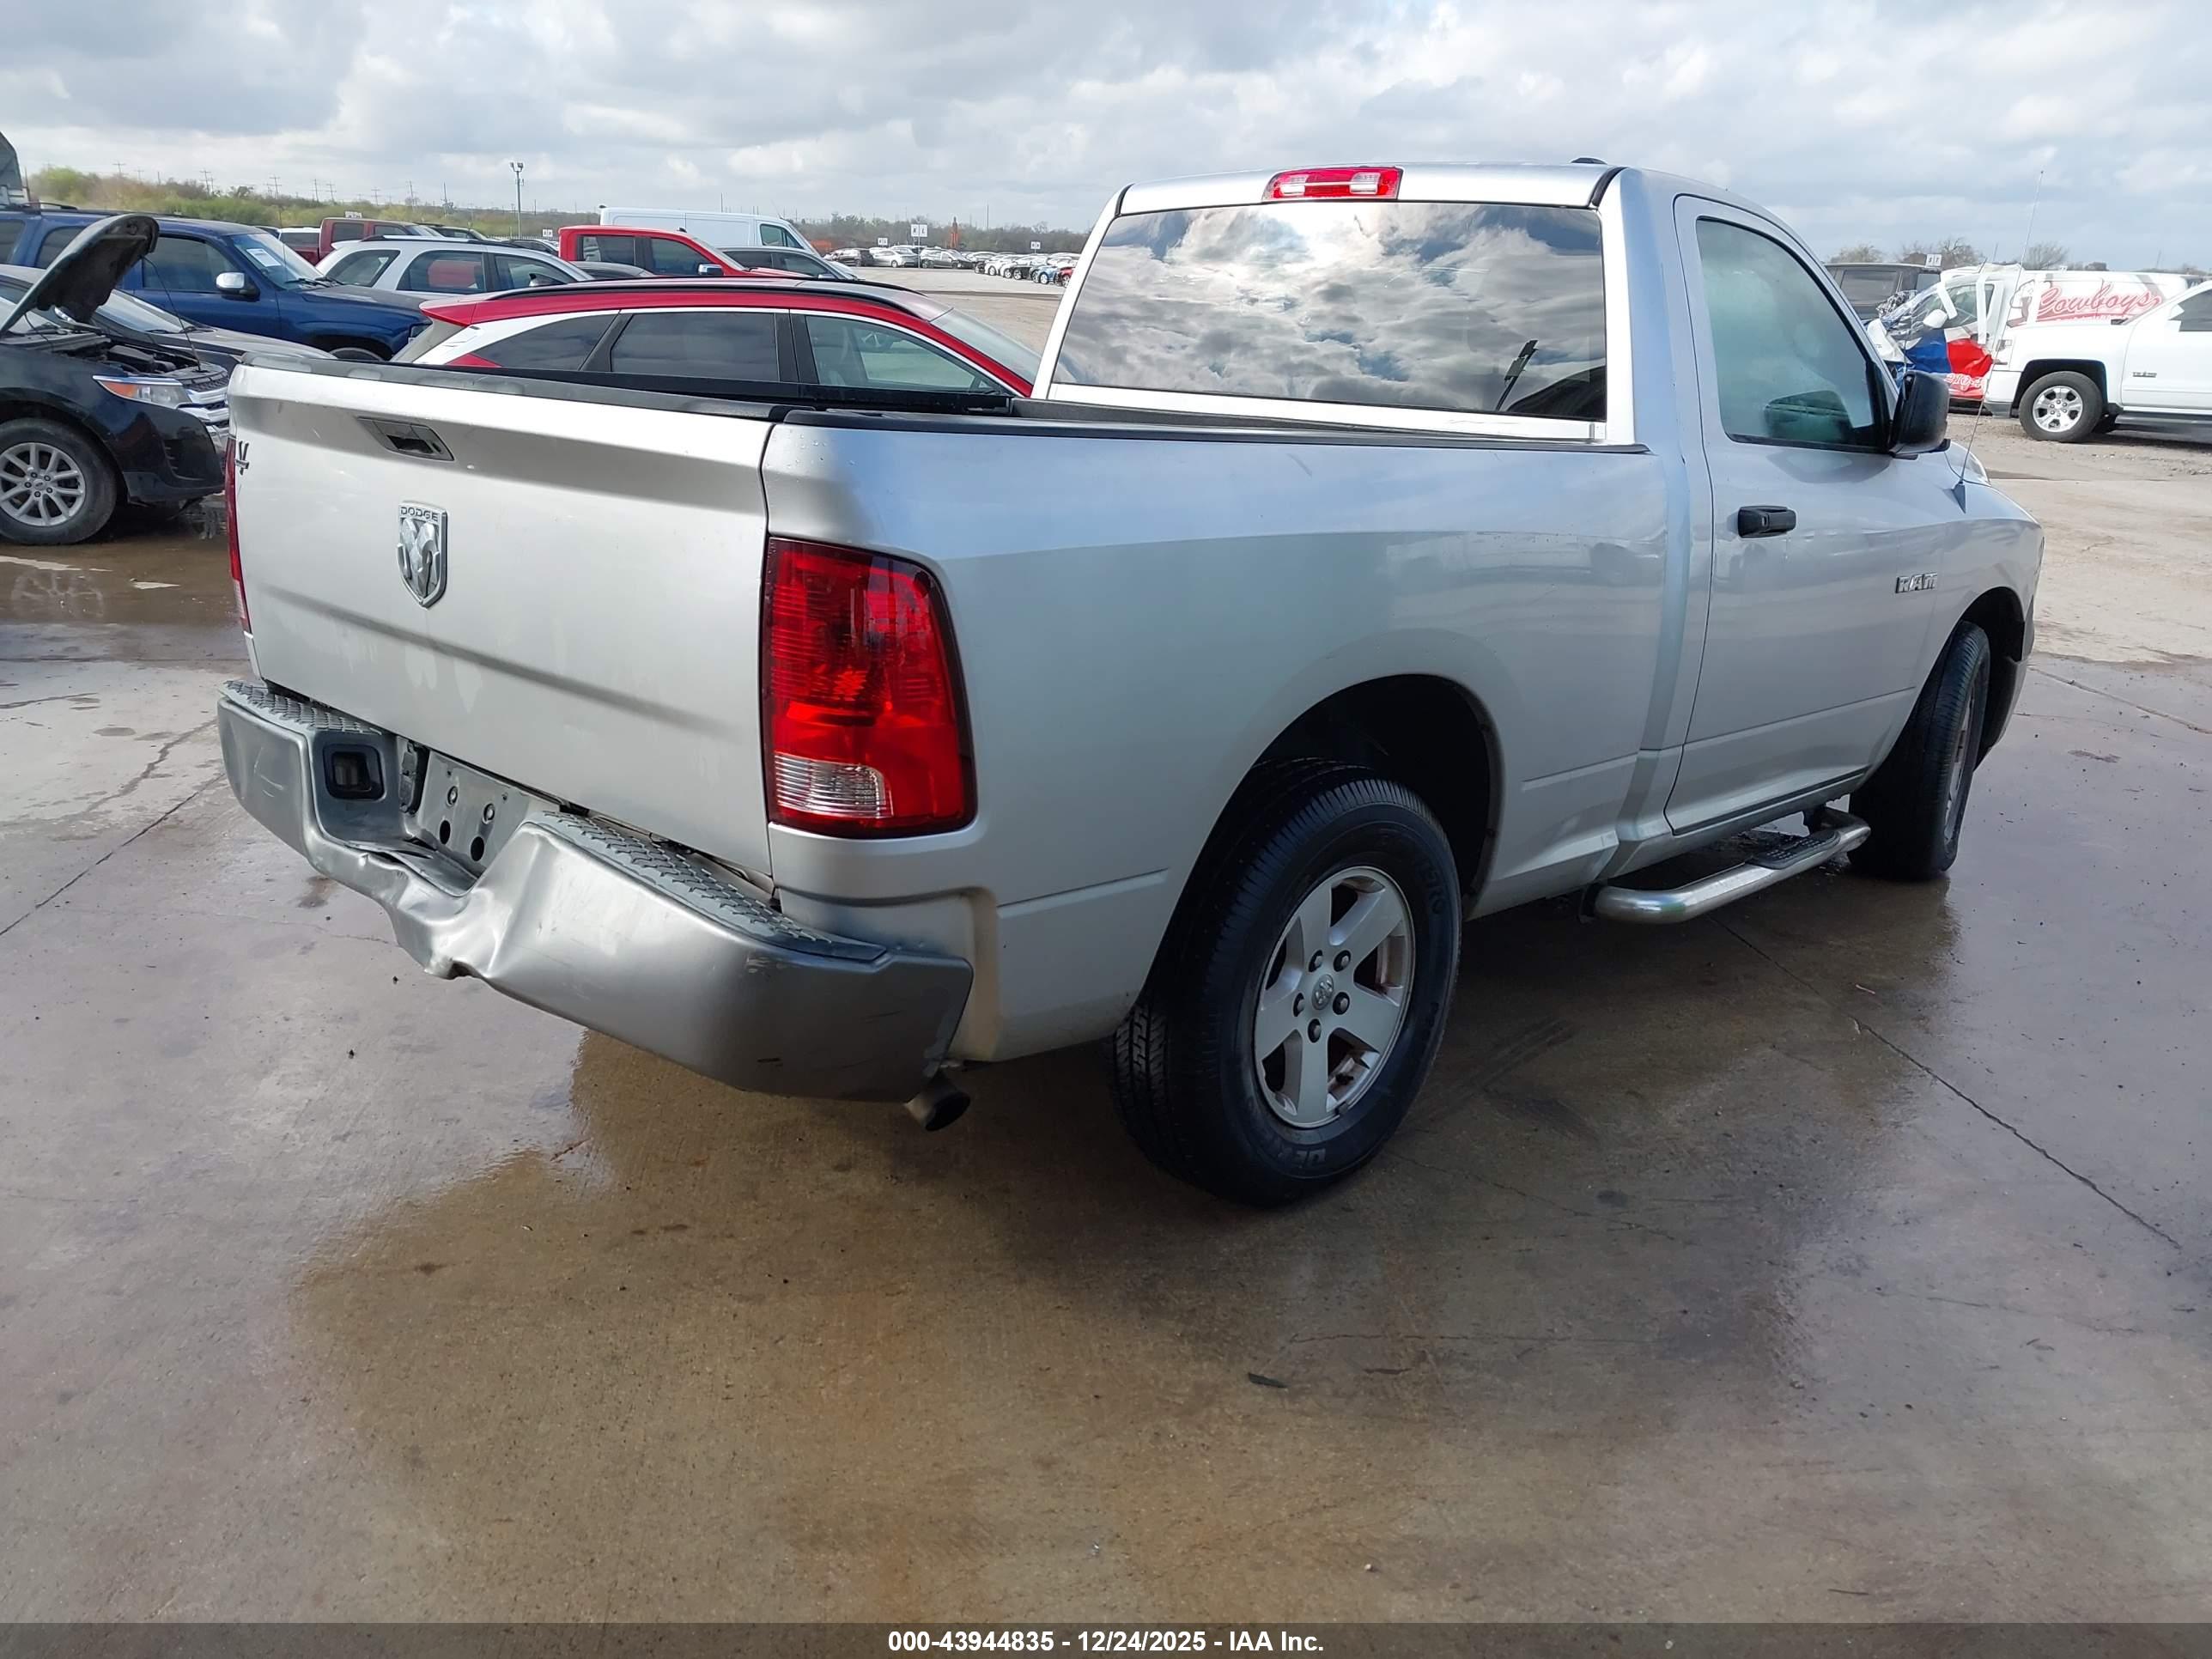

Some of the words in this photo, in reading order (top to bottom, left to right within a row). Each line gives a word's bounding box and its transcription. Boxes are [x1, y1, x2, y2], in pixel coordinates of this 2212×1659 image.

[2038, 283, 2161, 316] Cowboys
[400, 506, 440, 522] DODGE
[1895, 572, 1937, 593] RAM
